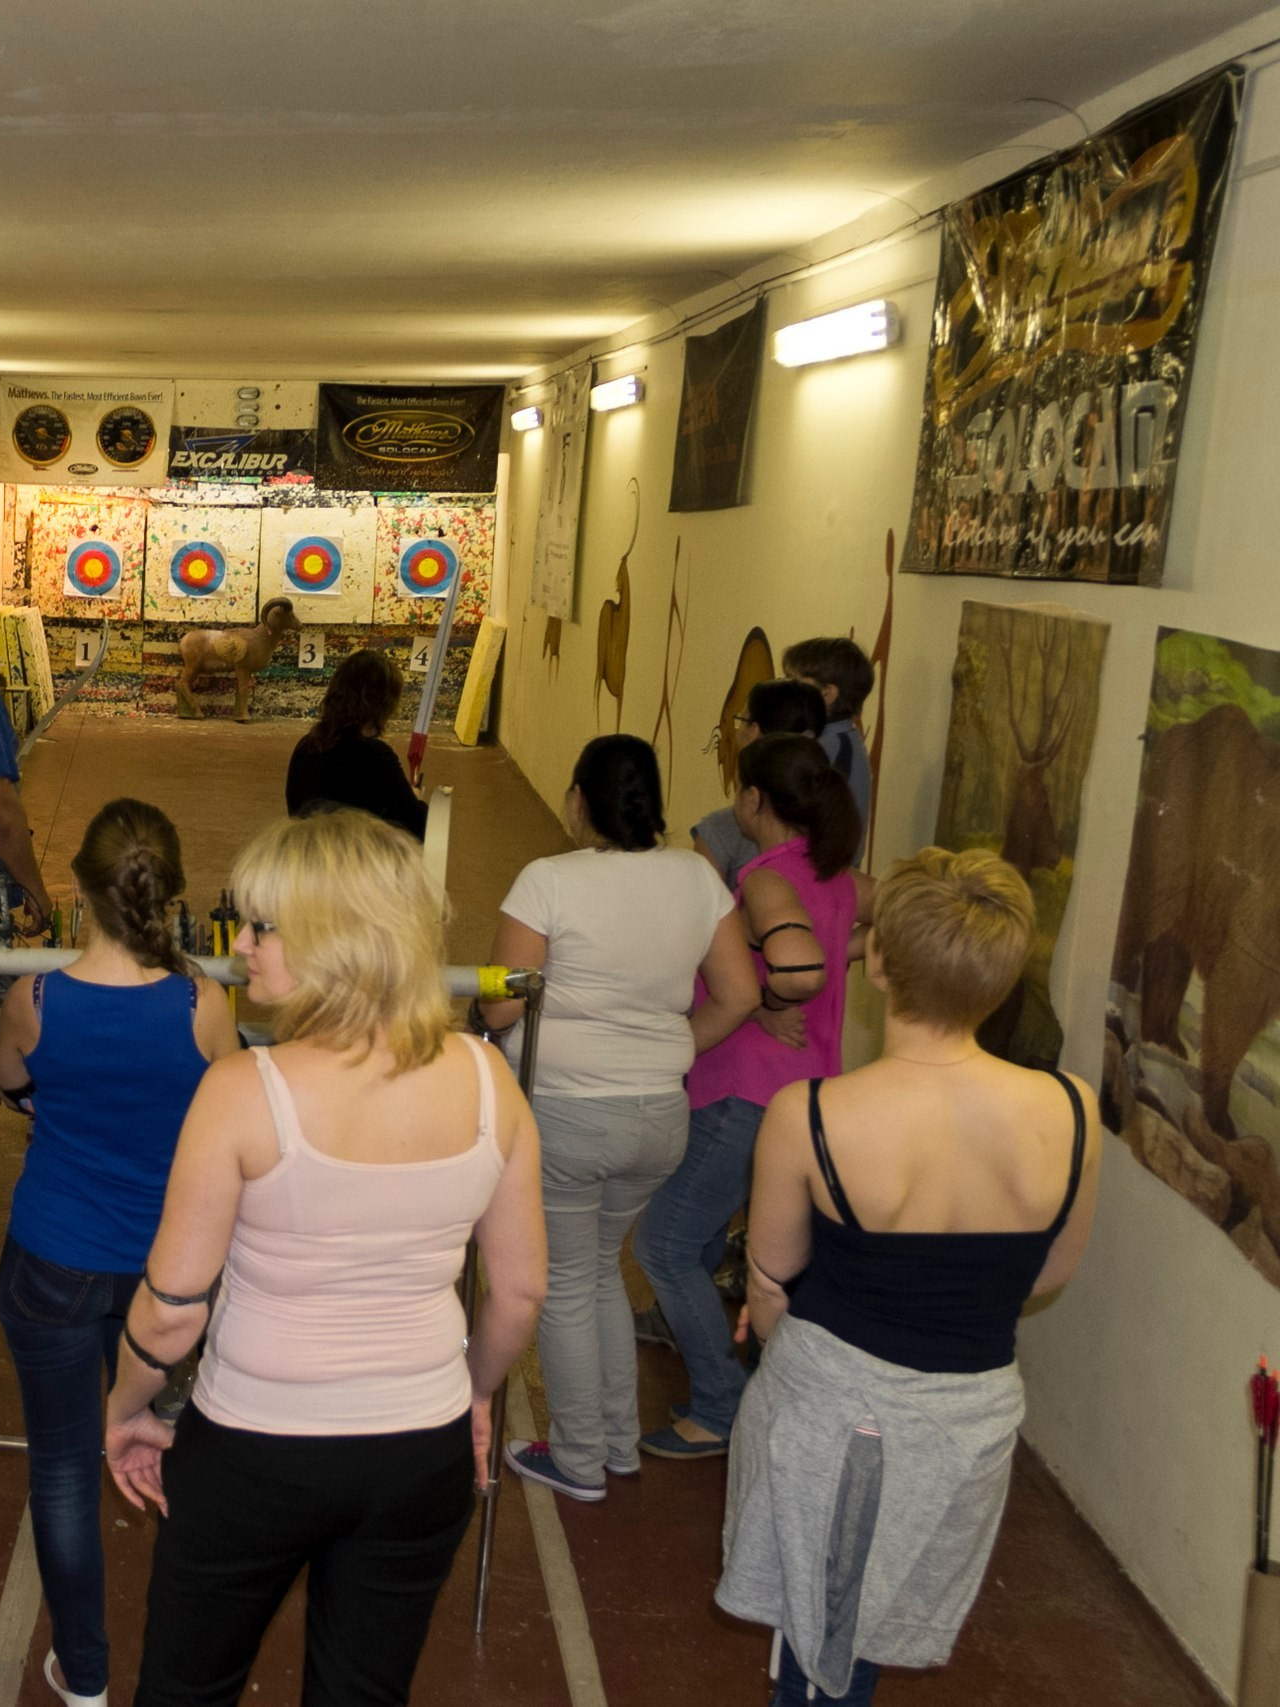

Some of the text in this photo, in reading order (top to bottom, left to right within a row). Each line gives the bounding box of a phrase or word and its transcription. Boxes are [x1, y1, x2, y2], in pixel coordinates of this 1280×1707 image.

[51, 391, 63, 400] The
[87, 392, 103, 400] Most
[104, 391, 129, 401] Efficient
[130, 392, 147, 401] Bows
[148, 392, 163, 401] Ever!
[365, 419, 458, 444] Mathews
[171, 450, 288, 469] EXCALIBUR
[378, 446, 437, 454] SOLOCAM
[1055, 524, 1108, 563] you
[81, 642, 91, 661] 1
[302, 643, 317, 664] 3
[414, 645, 430, 667] 4
